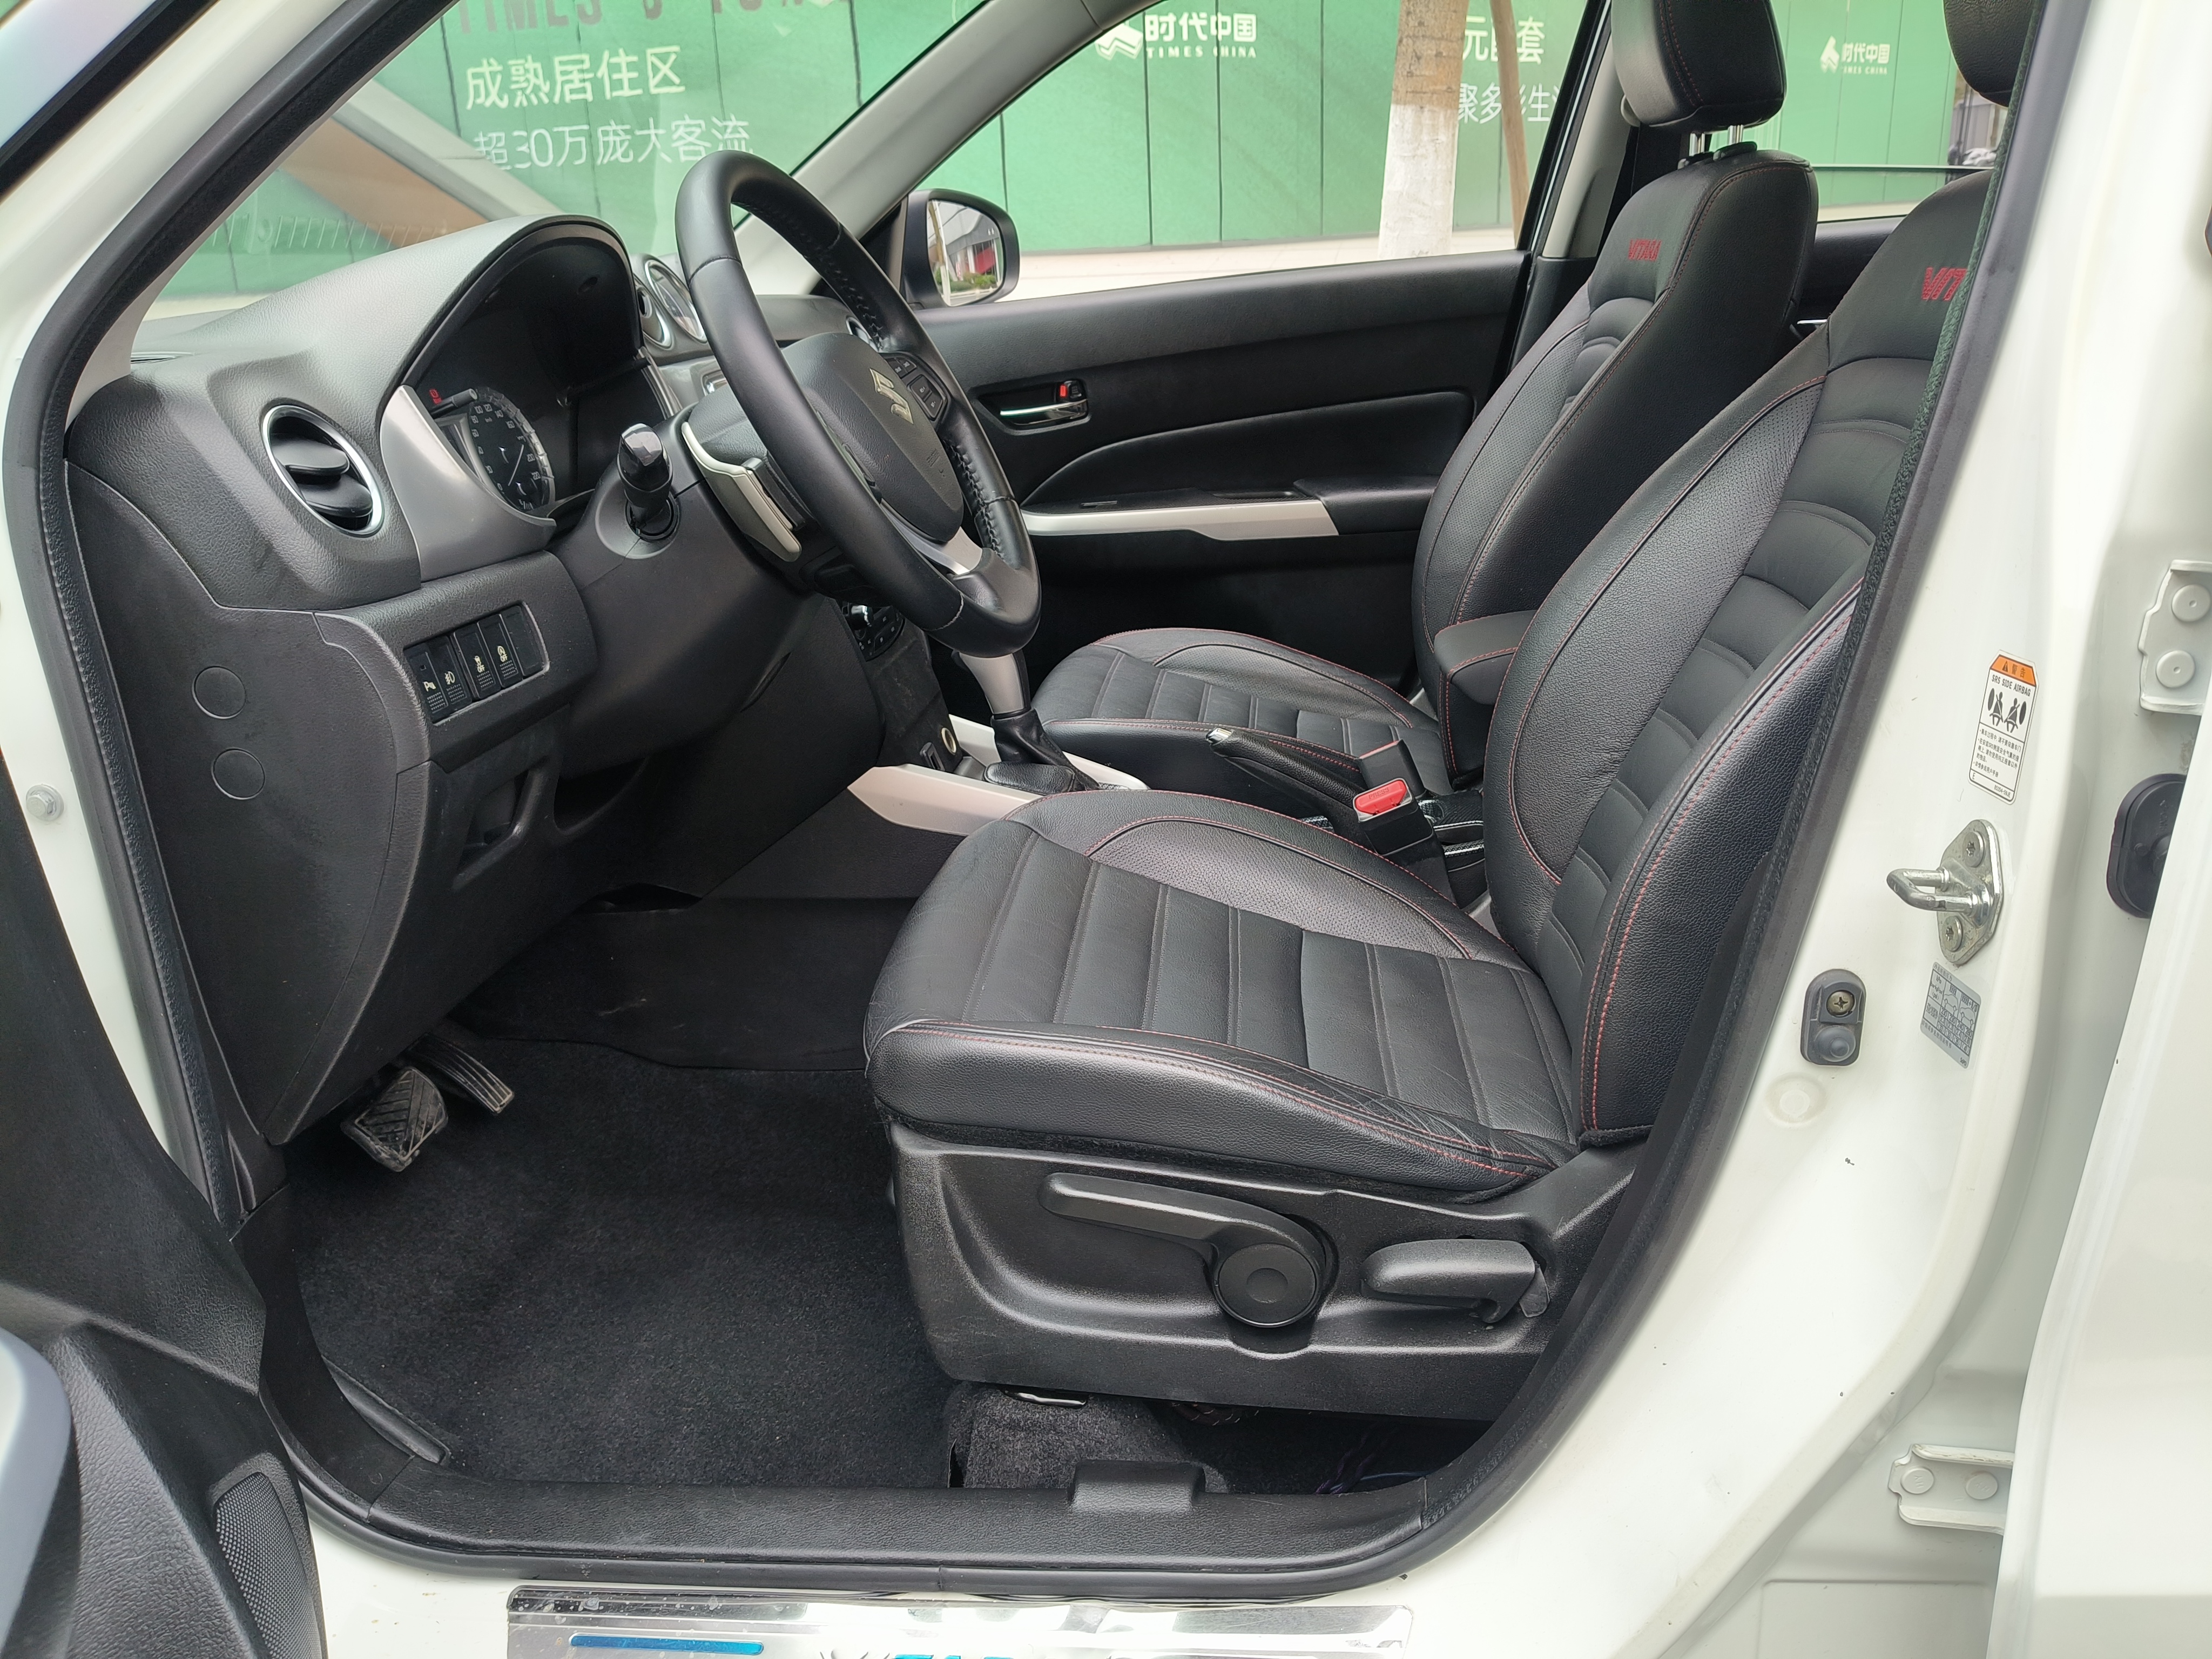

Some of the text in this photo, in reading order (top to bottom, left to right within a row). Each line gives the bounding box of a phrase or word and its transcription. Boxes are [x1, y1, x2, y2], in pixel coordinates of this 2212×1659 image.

[1145, 12, 1257, 42] 时代中国
[1462, 15, 1545, 65] 元套
[1146, 45, 1257, 58] TIMES CHINA
[1841, 42, 1891, 64] 时代中国
[466, 45, 685, 110] 成熟居住区
[1458, 82, 1560, 124] 聚多生
[474, 113, 753, 170] 超30万庞大客流
[1992, 674, 2031, 697] SRS SIDE AIRBAG
[1368, 787, 1390, 800] PRESS
